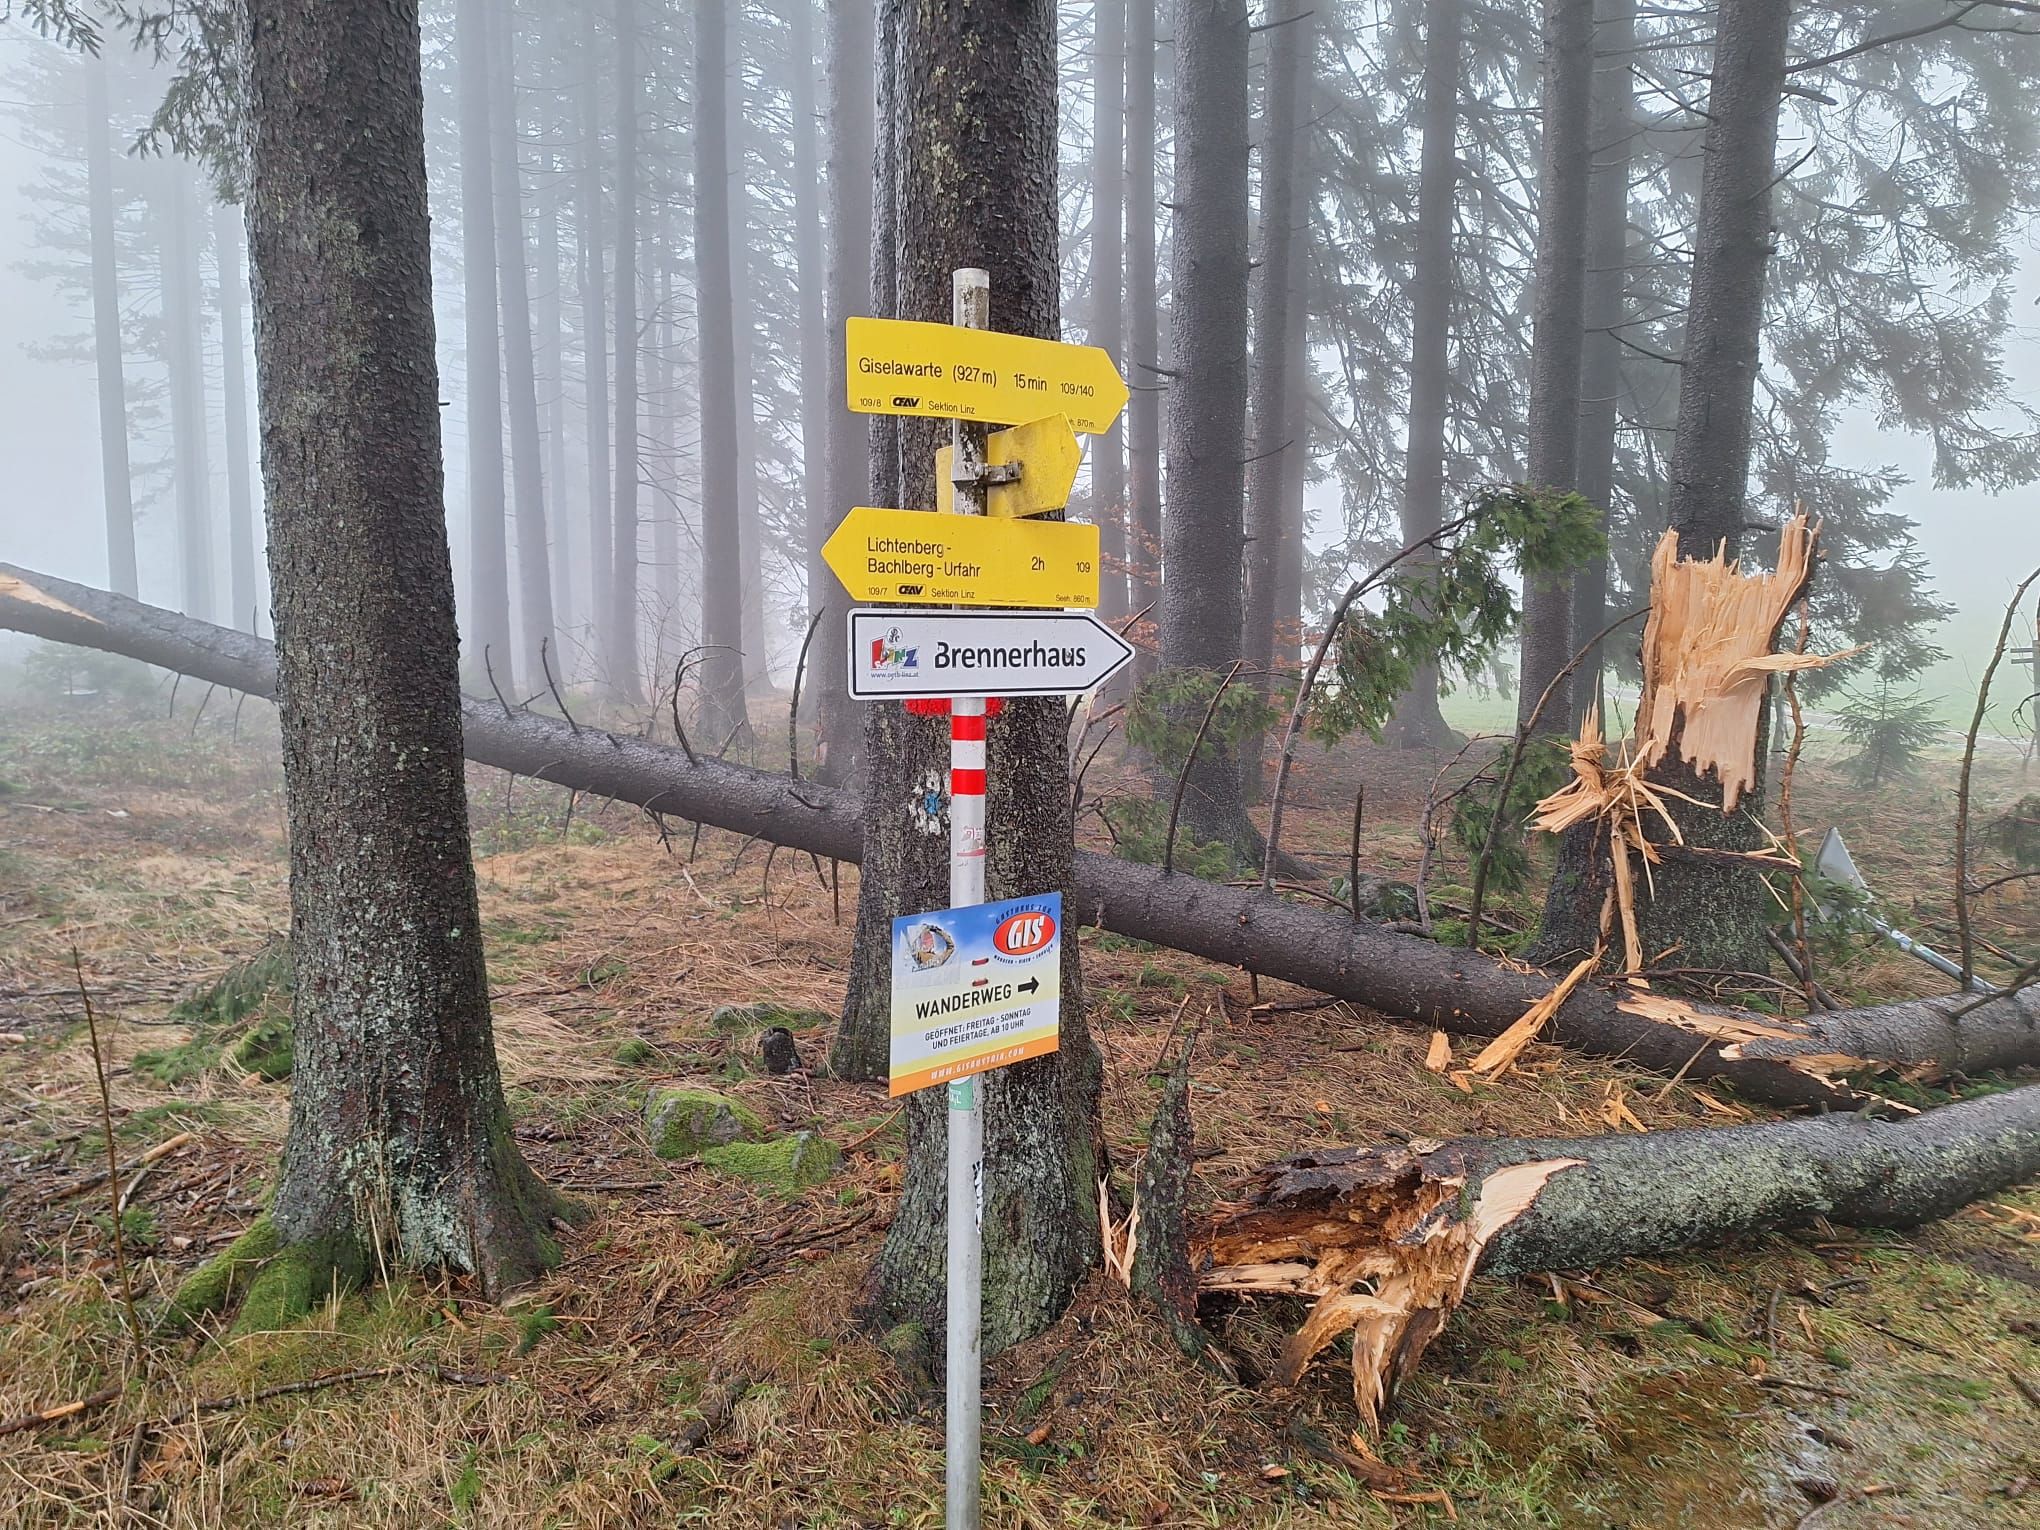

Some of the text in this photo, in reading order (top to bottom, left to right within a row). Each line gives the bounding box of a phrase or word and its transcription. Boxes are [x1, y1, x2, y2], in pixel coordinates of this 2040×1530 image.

[858, 357, 943, 378] Giselawarte
[1060, 382, 1094, 397] 109/140
[860, 398, 882, 407] 109/8
[928, 400, 958, 412] Sektion
[960, 404, 976, 415] Linz
[1031, 557, 1045, 571] 2h
[1076, 562, 1091, 573] 109
[868, 587, 888, 596] 109/7
[931, 588, 959, 598] Sektion
[961, 589, 975, 599] Linz
[934, 639, 1086, 669] Brennerhaus
[1007, 914, 1046, 951] GIS
[915, 983, 1012, 1020] WANDERWEG
[924, 1024, 965, 1041] GEÖFFNET:
[966, 1015, 995, 1030] FREITAG
[1000, 1007, 1031, 1022] SONNTAG
[932, 1019, 1025, 1050] UND FEIERTAGE, AB 10 UHR
